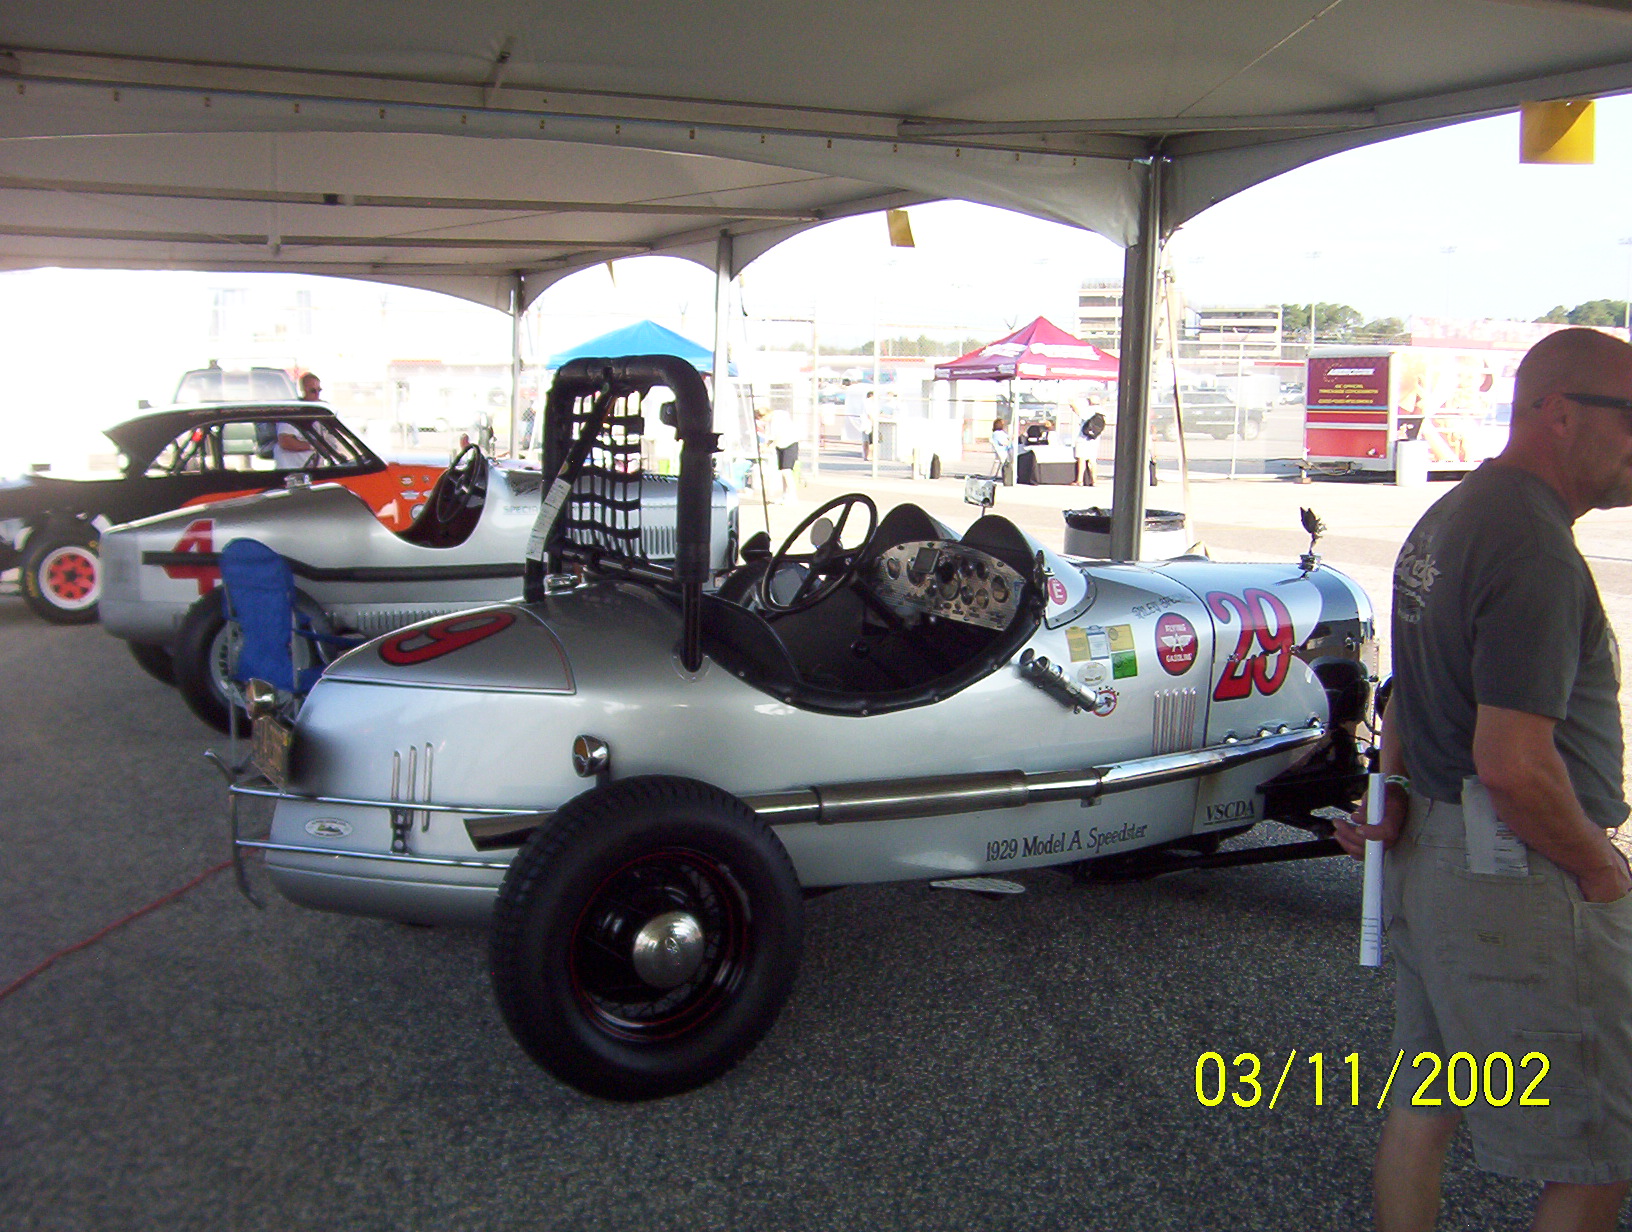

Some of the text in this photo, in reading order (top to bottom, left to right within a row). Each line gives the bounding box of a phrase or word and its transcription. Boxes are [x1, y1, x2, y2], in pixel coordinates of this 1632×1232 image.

[161, 518, 223, 597] 4
[1053, 581, 1065, 600] E
[378, 610, 517, 667] 9
[1165, 652, 1193, 663] GASOLINE
[1205, 587, 1295, 702] 29
[1206, 799, 1255, 822] VSCDA
[985, 822, 1148, 863] 1929 Model A Speedster
